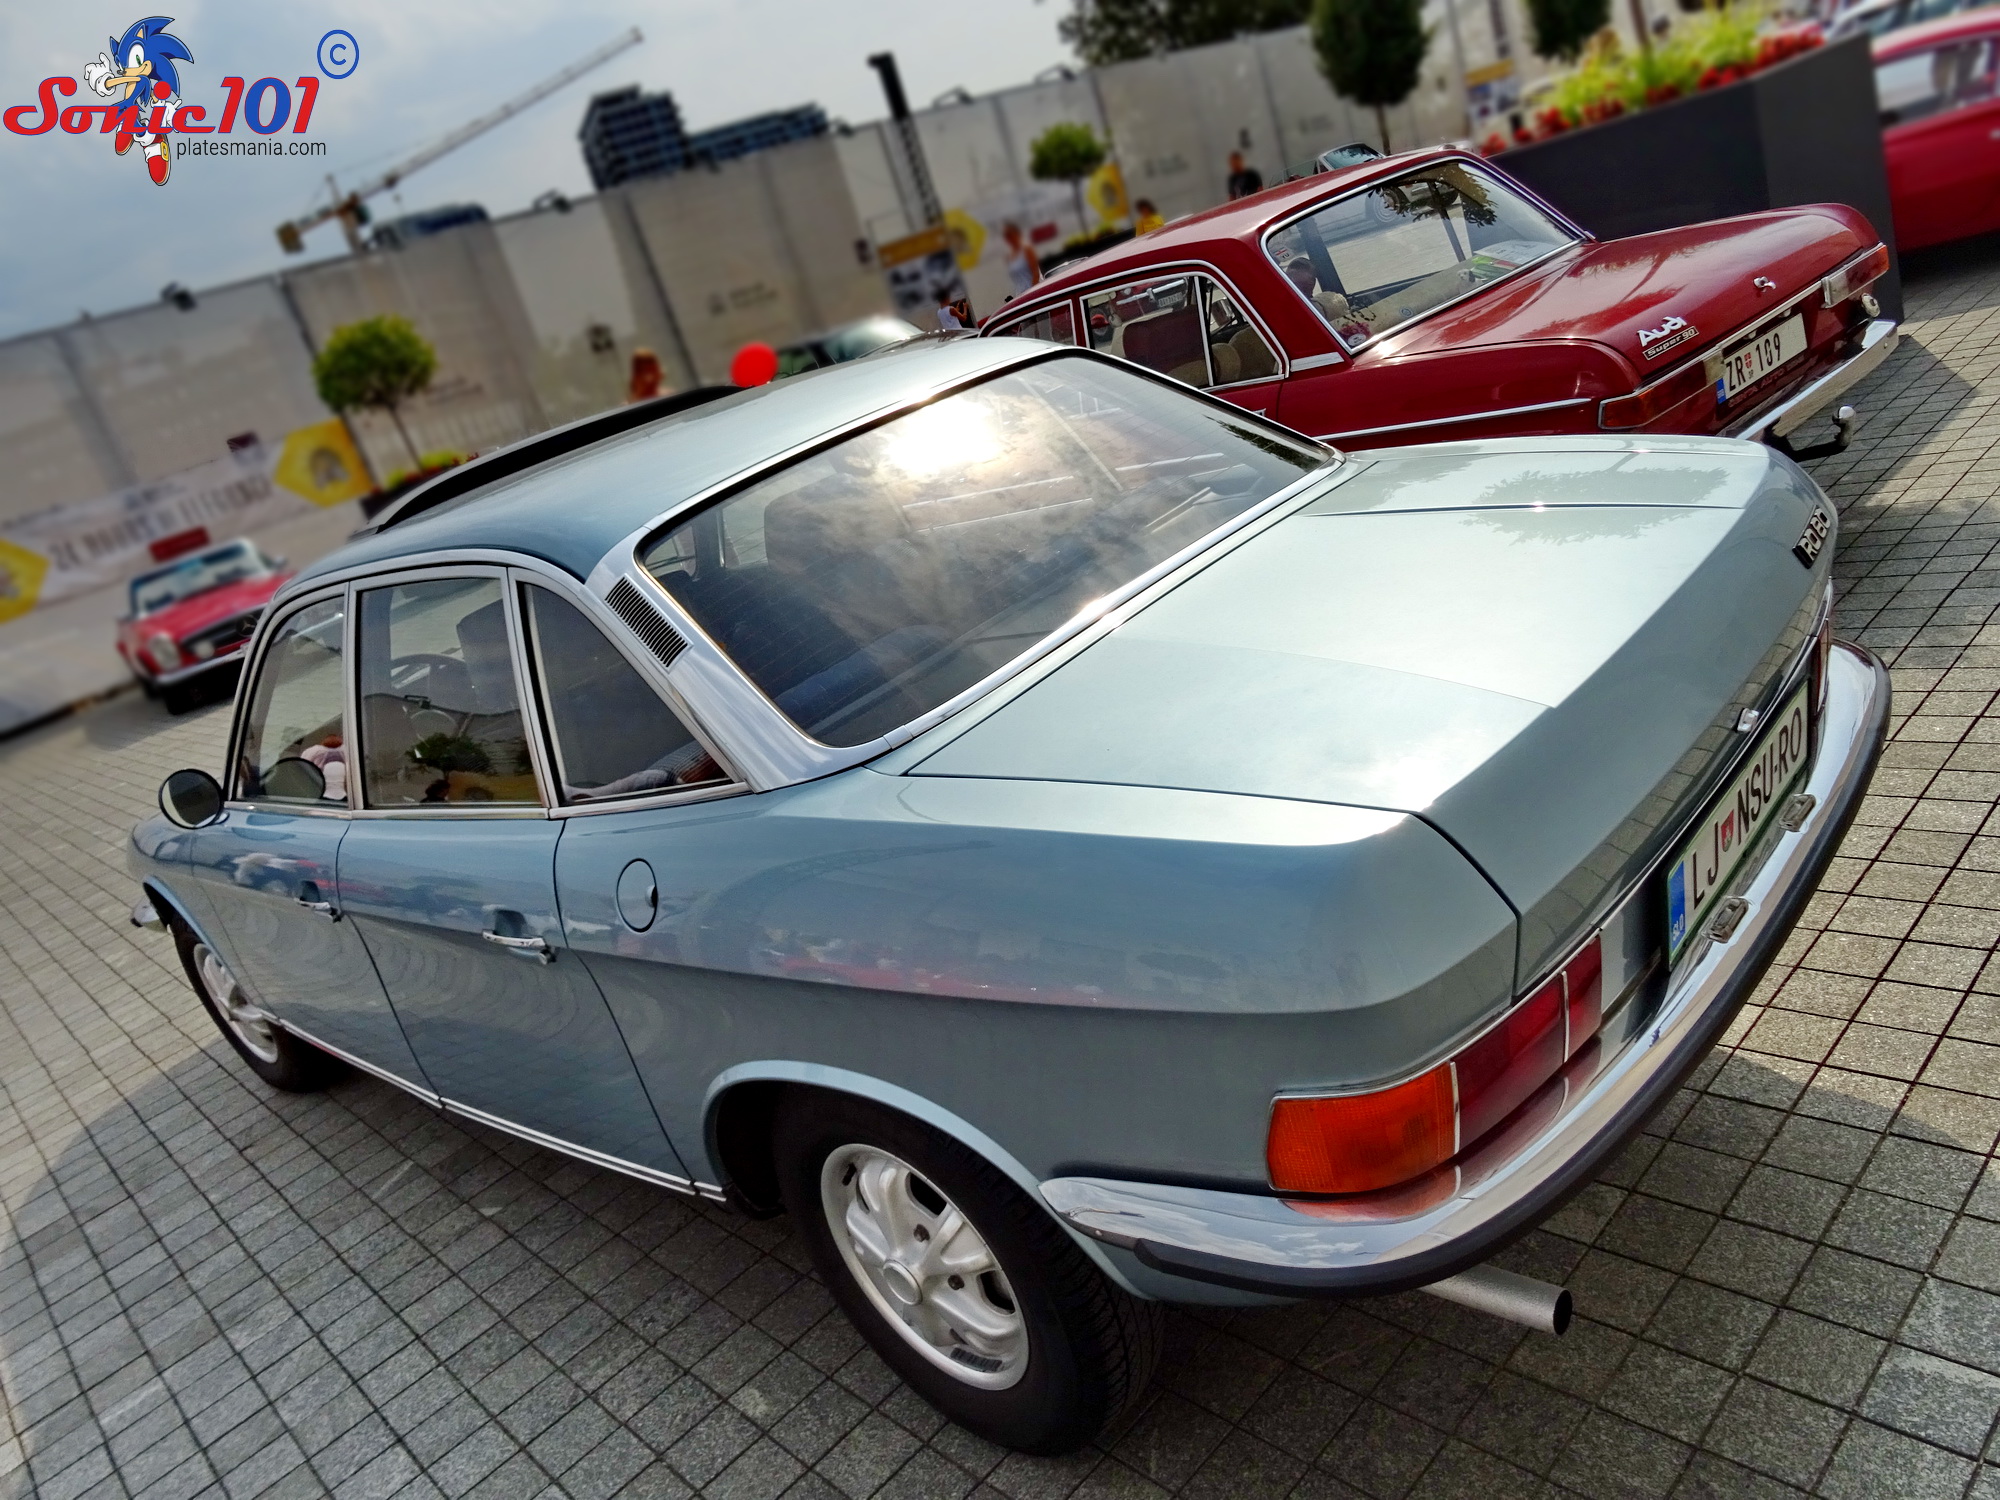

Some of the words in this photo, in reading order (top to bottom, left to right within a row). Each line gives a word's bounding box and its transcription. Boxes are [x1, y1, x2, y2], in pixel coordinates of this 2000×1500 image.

[1637, 316, 1688, 347] Audi
[1647, 335, 1681, 357] Super
[1681, 328, 1695, 341] 90
[1726, 356, 1746, 392] ZR
[1755, 333, 1781, 371] 109
[1692, 820, 1720, 910] LJ
[1737, 706, 1801, 846] NSU-RO
